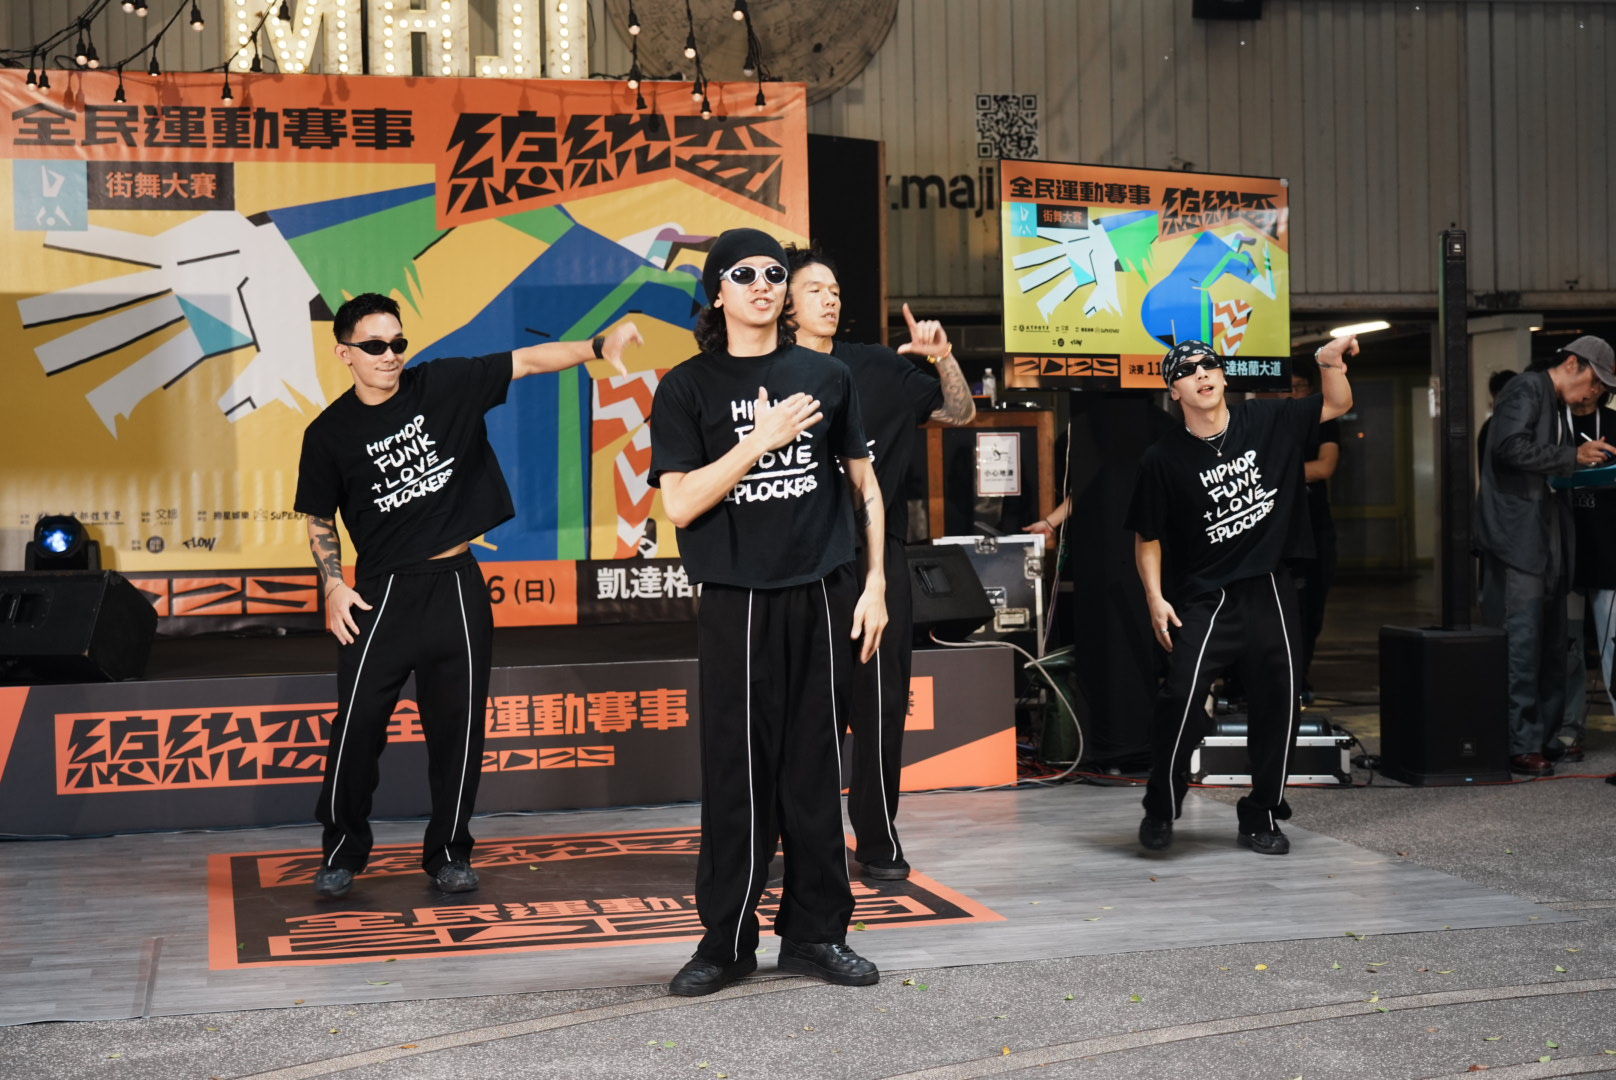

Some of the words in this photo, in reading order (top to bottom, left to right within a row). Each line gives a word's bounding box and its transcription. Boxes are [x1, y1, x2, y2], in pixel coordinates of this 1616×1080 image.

[12, 103, 414, 150] 全民運動賽事
[106, 171, 217, 200] 街舞大賽
[886, 166, 994, 218] .maji
[1010, 176, 1151, 205] 全民運動賽事
[1043, 209, 1083, 225] 街舞大賽
[366, 415, 425, 456] HIPHOP
[373, 433, 436, 473] FUNK
[385, 450, 439, 489] LOVE
[752, 445, 812, 469] OVE
[1199, 450, 1257, 487] HIPHOP
[1208, 467, 1261, 502] FUNK
[1217, 484, 1266, 518] LOVE
[182, 537, 216, 551] FLOW
[597, 565, 703, 600] 凱達格
